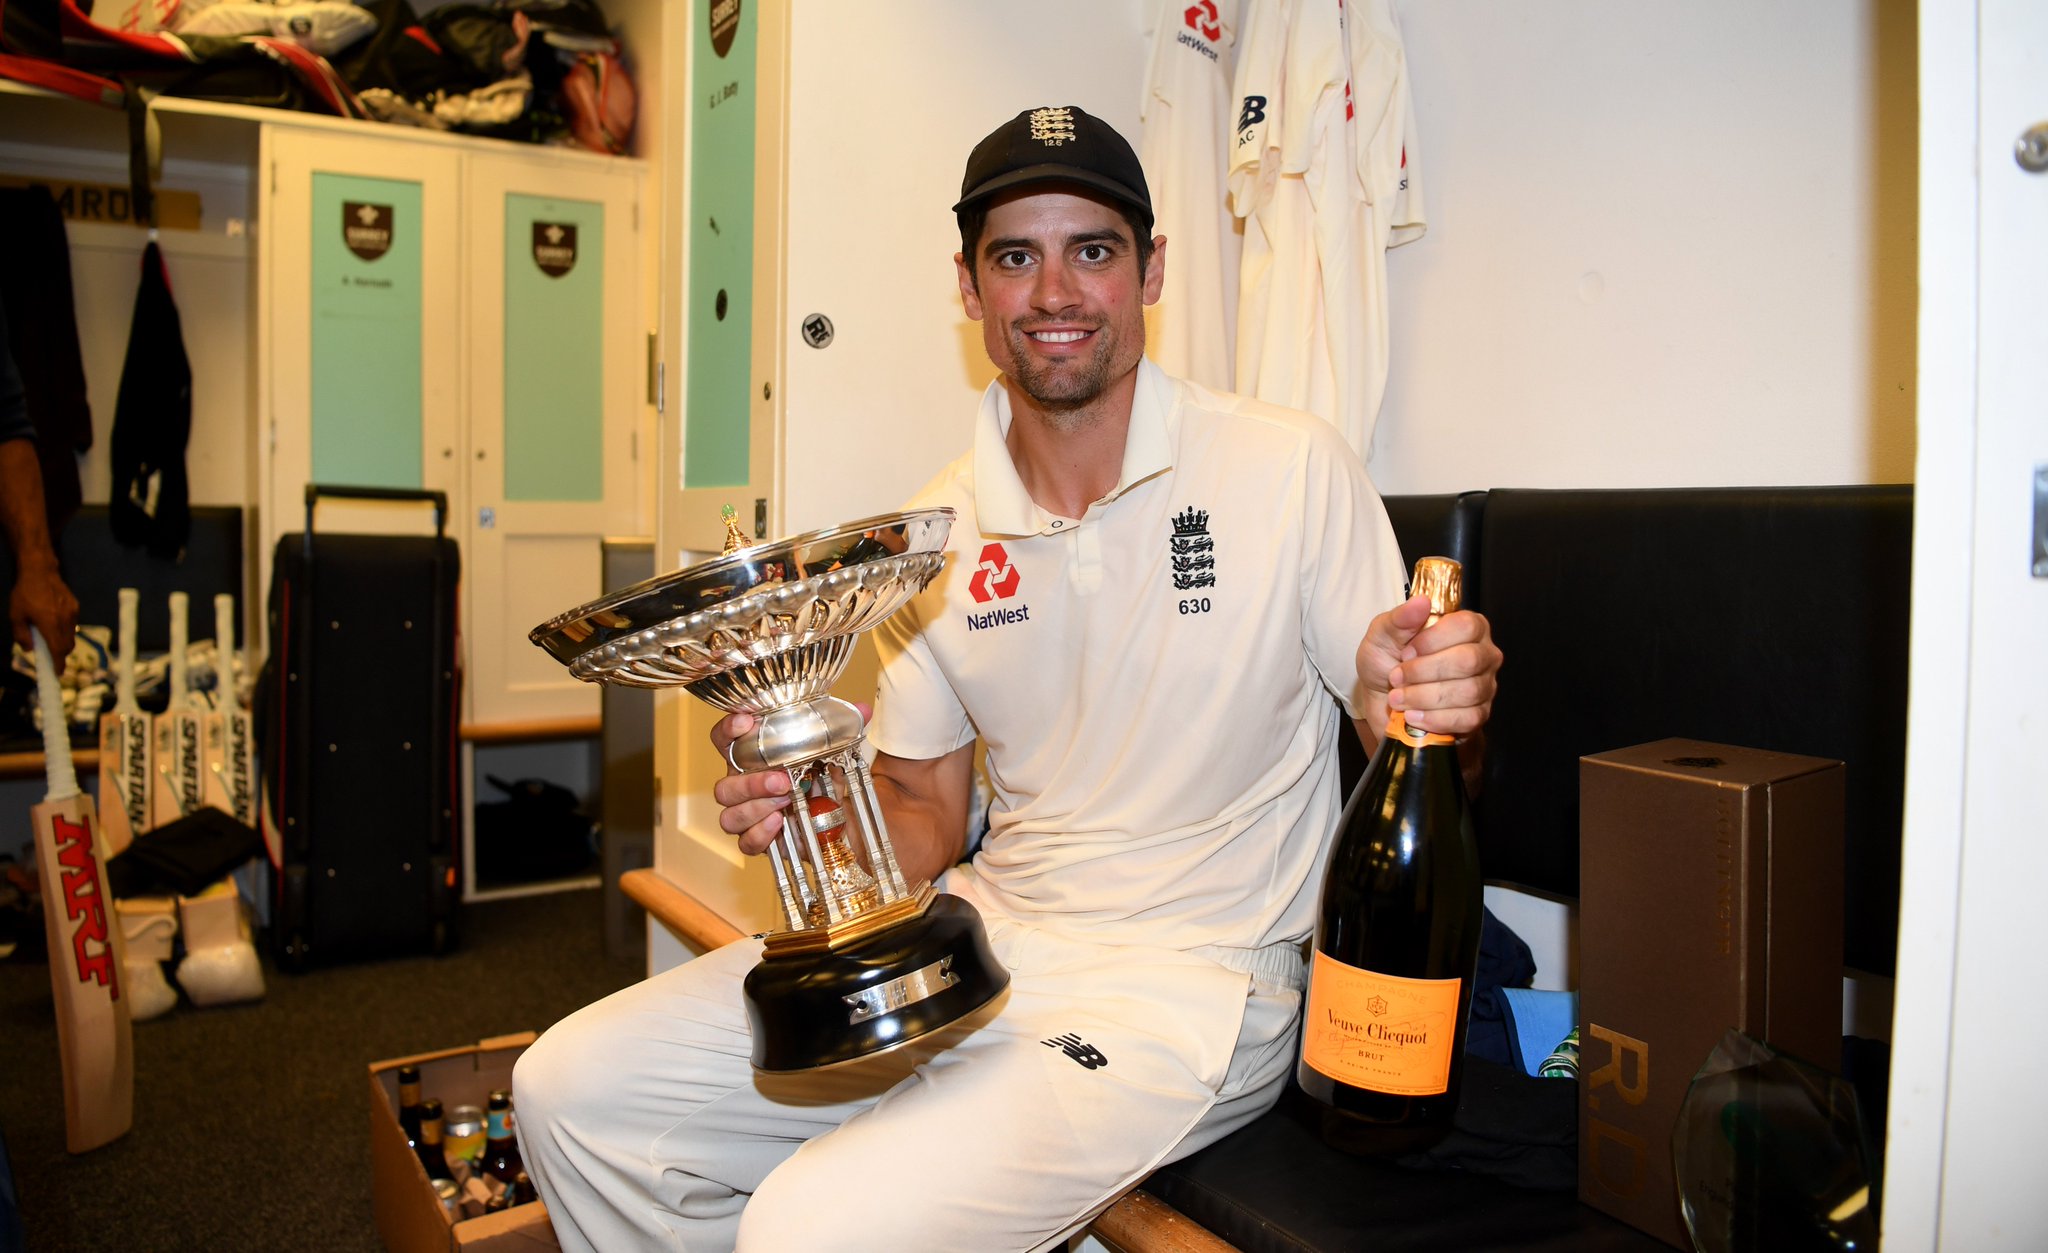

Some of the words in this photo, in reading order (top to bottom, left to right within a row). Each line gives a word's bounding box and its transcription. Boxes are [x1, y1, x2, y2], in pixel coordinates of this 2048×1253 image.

[967, 604, 1030, 632] NatWest
[1178, 597, 1211, 615] 630
[129, 716, 145, 826] SPARTAN
[52, 813, 120, 1001] MRF
[1328, 1008, 1363, 1034] Veuve
[1367, 1022, 1428, 1047] Clicquot
[1358, 1049, 1386, 1062] BRUT
